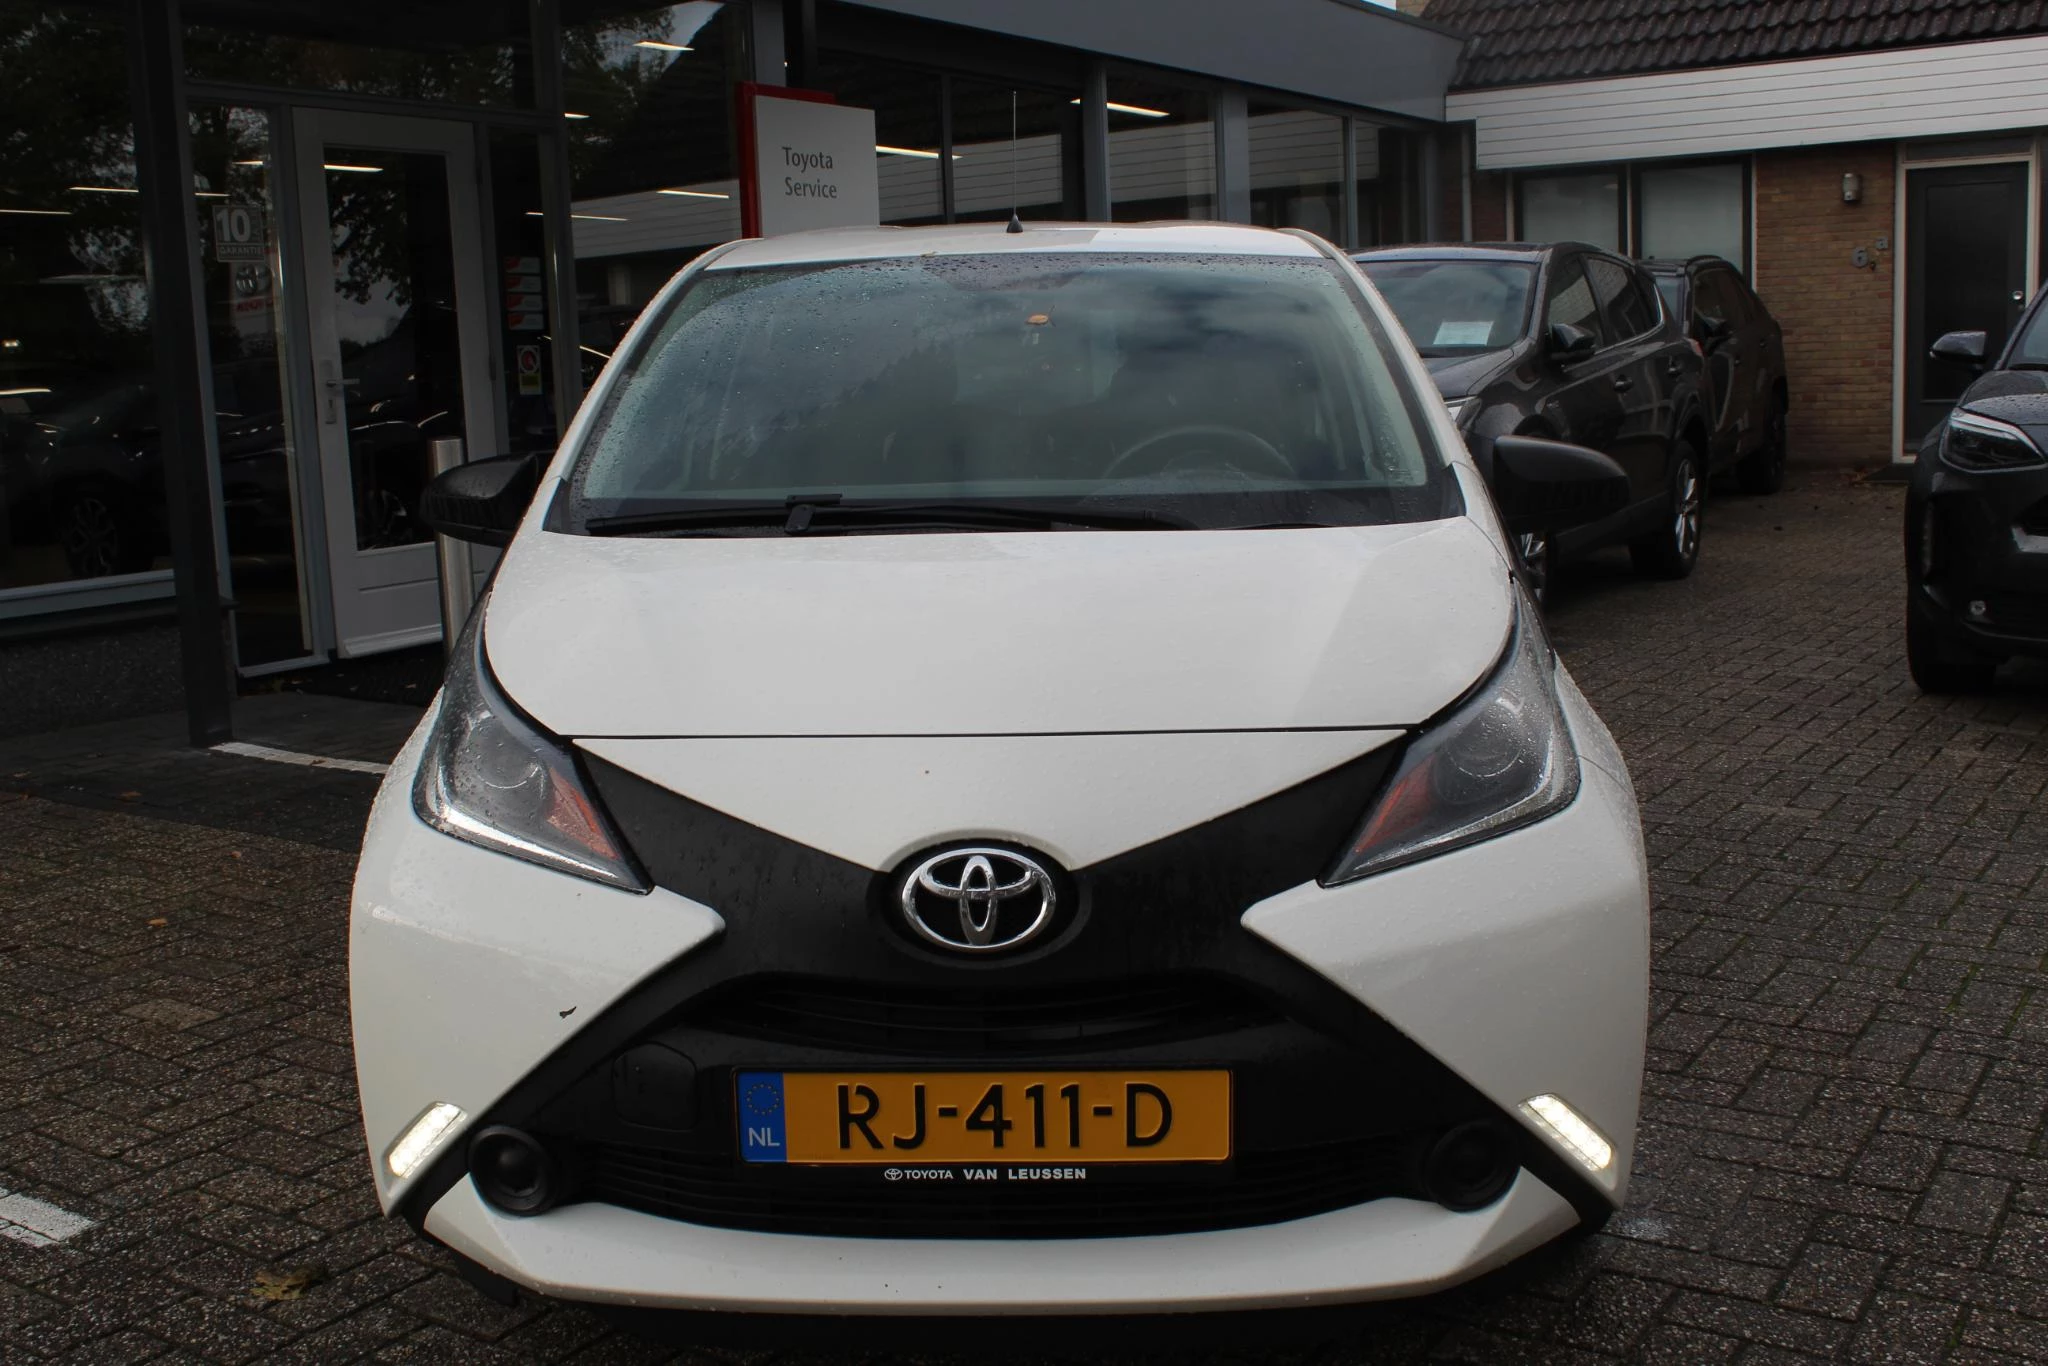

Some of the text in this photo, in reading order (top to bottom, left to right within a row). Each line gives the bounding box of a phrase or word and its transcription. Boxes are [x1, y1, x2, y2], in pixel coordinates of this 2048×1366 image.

[782, 146, 833, 173] Toyota
[785, 177, 837, 198] Service
[216, 208, 251, 242] 10
[837, 1083, 1172, 1149] RJ-411-D
[748, 1128, 781, 1147] NL
[905, 1168, 1087, 1180] TOYOTA VAN LEUSSEN
